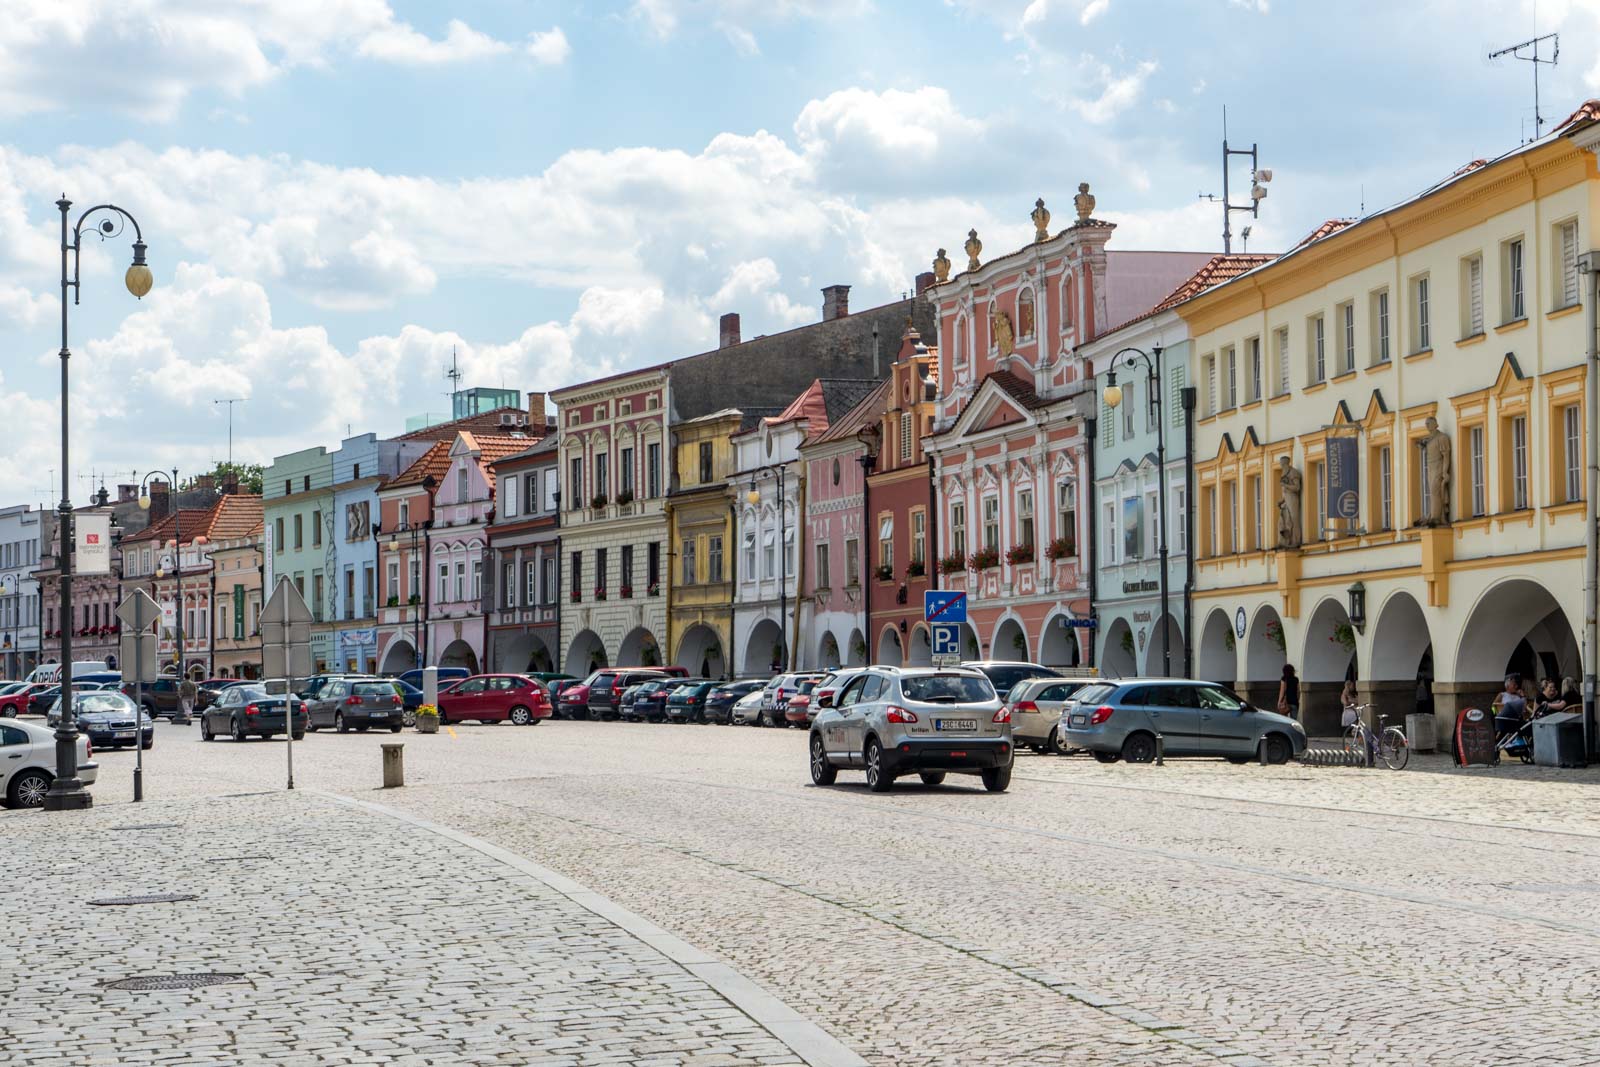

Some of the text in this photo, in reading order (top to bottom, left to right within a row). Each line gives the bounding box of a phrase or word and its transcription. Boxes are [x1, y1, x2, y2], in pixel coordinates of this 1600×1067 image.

[1330, 442, 1339, 488] EVROPA
[1064, 619, 1097, 628] UNIQA
[935, 628, 952, 652] P
[39, 671, 54, 683] DPD
